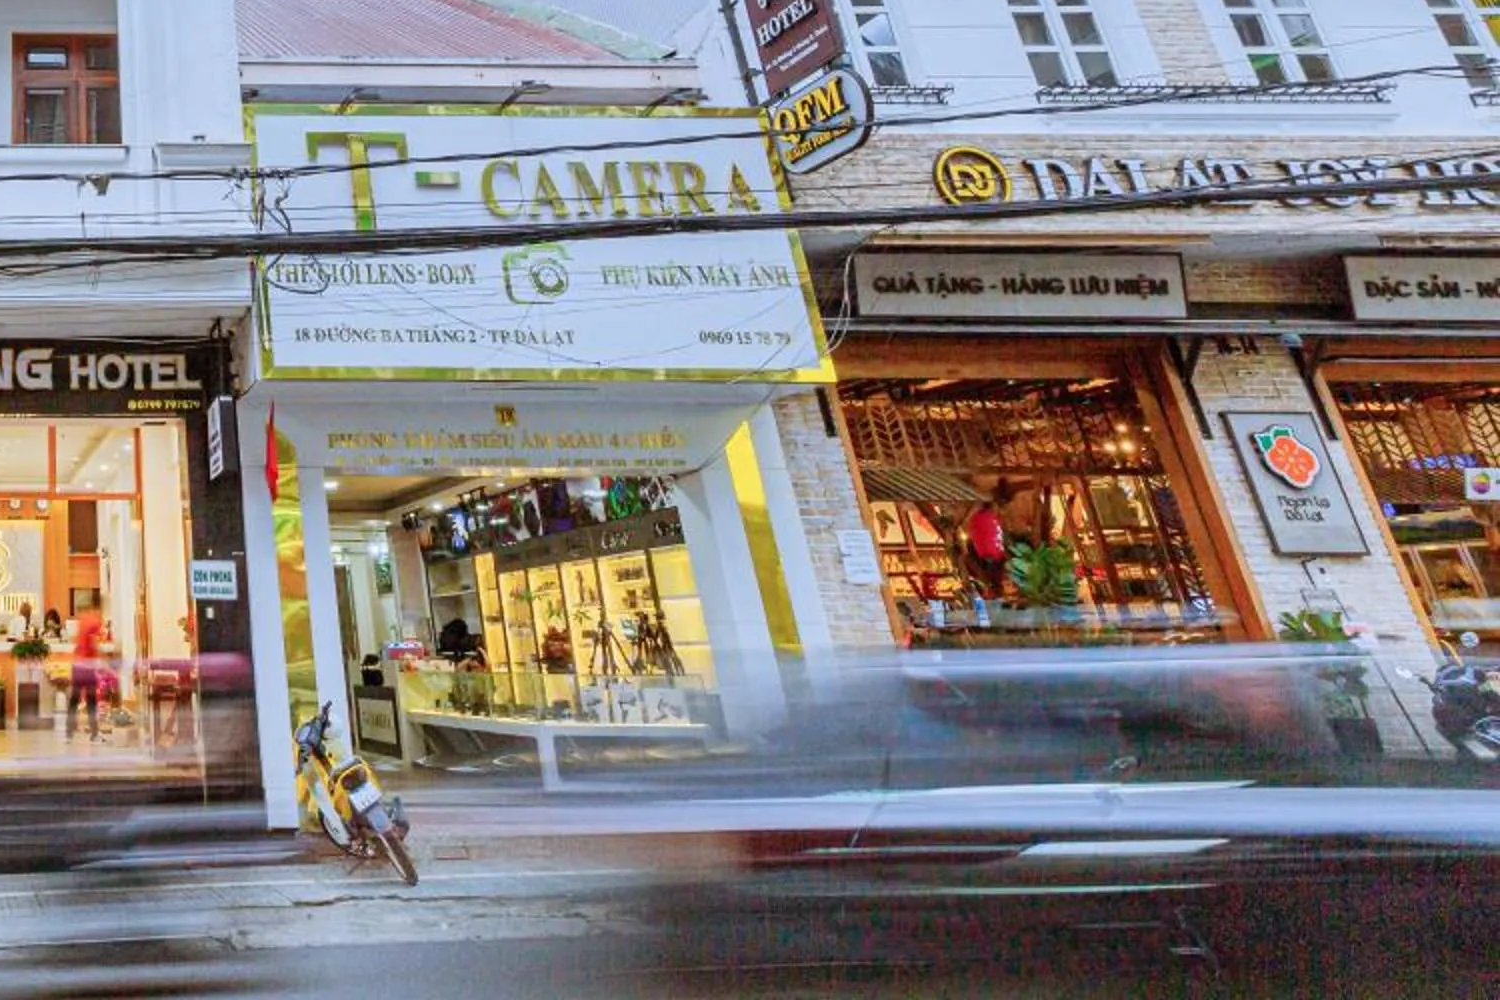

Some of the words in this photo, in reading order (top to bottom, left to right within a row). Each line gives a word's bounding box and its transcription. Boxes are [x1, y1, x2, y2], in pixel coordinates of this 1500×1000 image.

[773, 76, 845, 144] QFM
[305, 131, 408, 231] T
[365, 263, 418, 285] LENS
[427, 263, 477, 285] BODY
[872, 271, 921, 294] QUÀ
[925, 271, 984, 299] TẶNG
[1002, 272, 1065, 295] HÀNG
[1416, 274, 1460, 298] SẢN
[295, 328, 310, 343] 18
[380, 329, 402, 343] BA
[406, 323, 466, 344] THÁNG
[468, 329, 477, 343] 2
[700, 330, 733, 345] 0969
[68, 353, 202, 391] HOTEL
